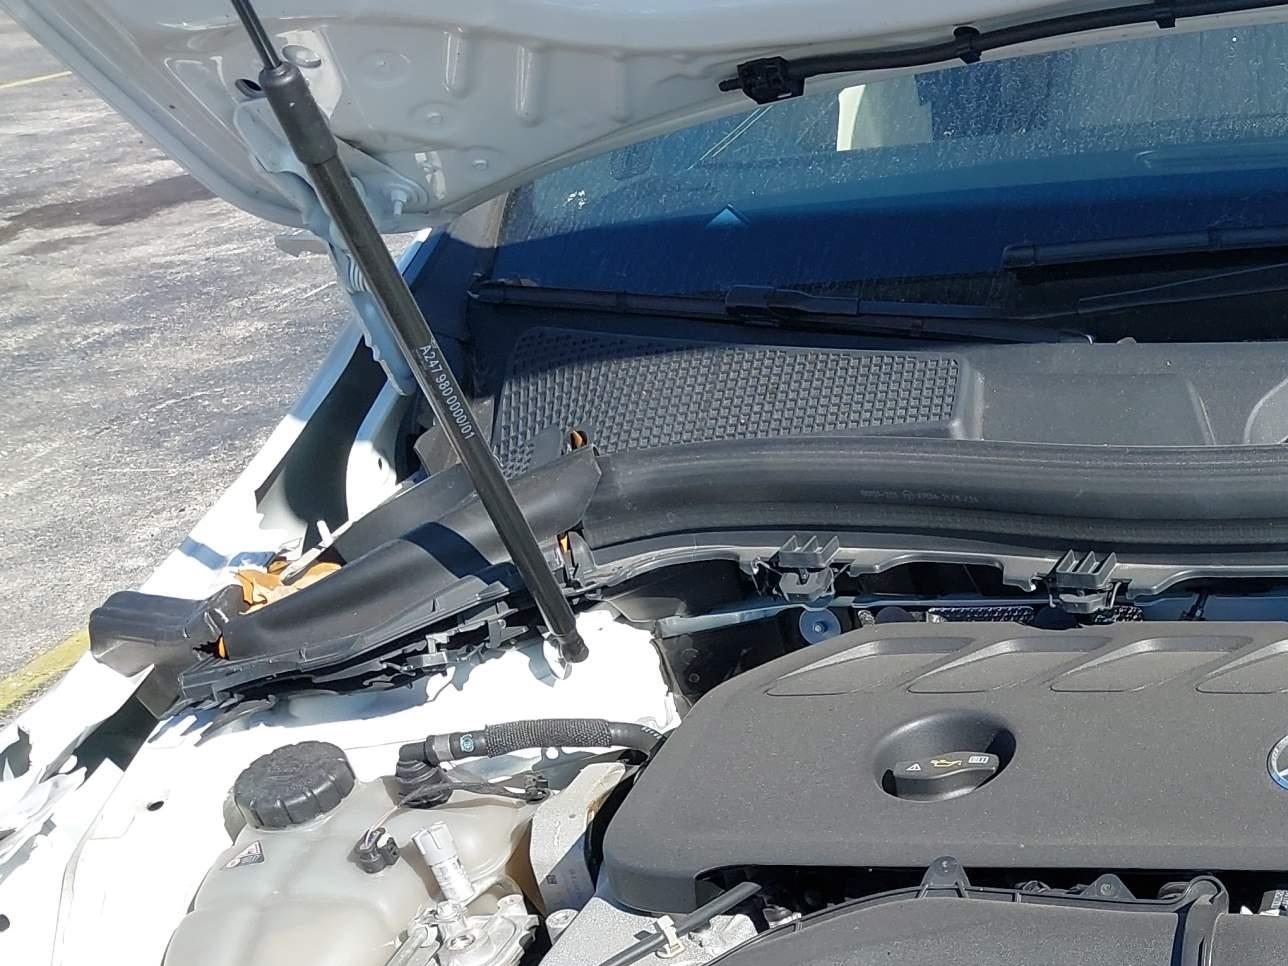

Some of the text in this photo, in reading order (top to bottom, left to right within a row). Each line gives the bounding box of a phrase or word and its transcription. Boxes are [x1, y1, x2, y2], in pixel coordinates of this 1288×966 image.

[420, 345, 475, 440] A247 980 0000/01
